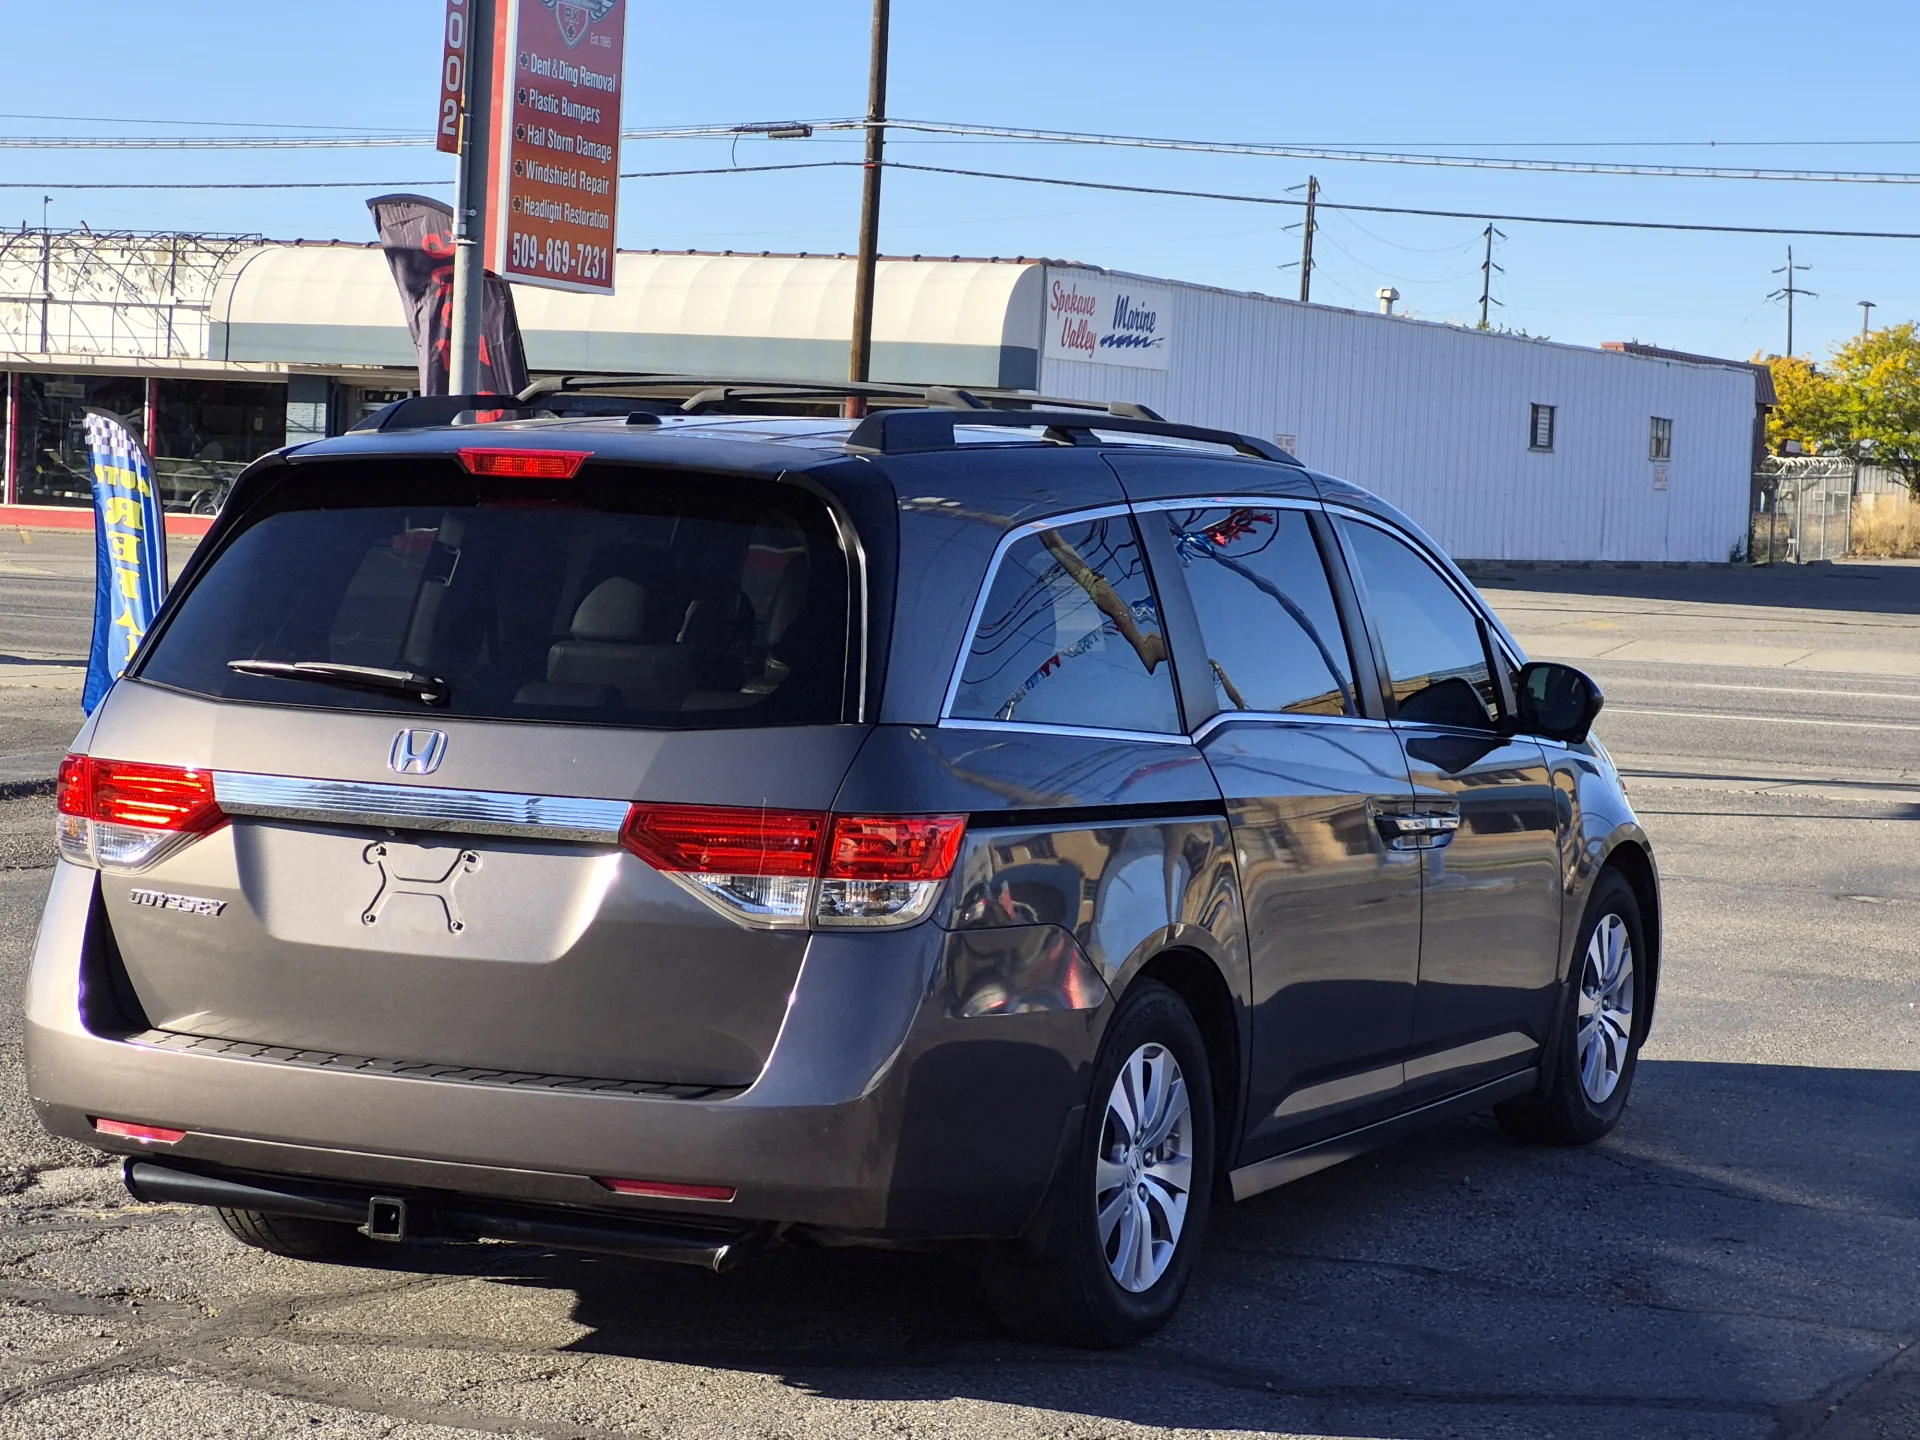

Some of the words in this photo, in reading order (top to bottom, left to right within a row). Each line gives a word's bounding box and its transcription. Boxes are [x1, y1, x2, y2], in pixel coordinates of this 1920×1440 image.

[442, 0, 464, 136] 002
[530, 53, 551, 77] Dent
[551, 58, 559, 79] &
[559, 60, 578, 88] Ding
[580, 65, 616, 92] Removal
[528, 88, 559, 114] Plastic
[561, 96, 601, 125] Bumpers
[527, 124, 545, 147] Hail
[547, 128, 574, 152] Storm
[576, 135, 612, 164] Damage
[525, 159, 577, 188] Windshield
[579, 171, 610, 196] Repair
[523, 195, 563, 224] Headlight
[564, 202, 609, 229] Restoration
[512, 232, 608, 280] 509-869-7231
[1050, 280, 1096, 320] Spokane
[1113, 294, 1156, 334] Marine
[1061, 317, 1097, 359] Valley
[128, 888, 228, 918] ODYSSEY
